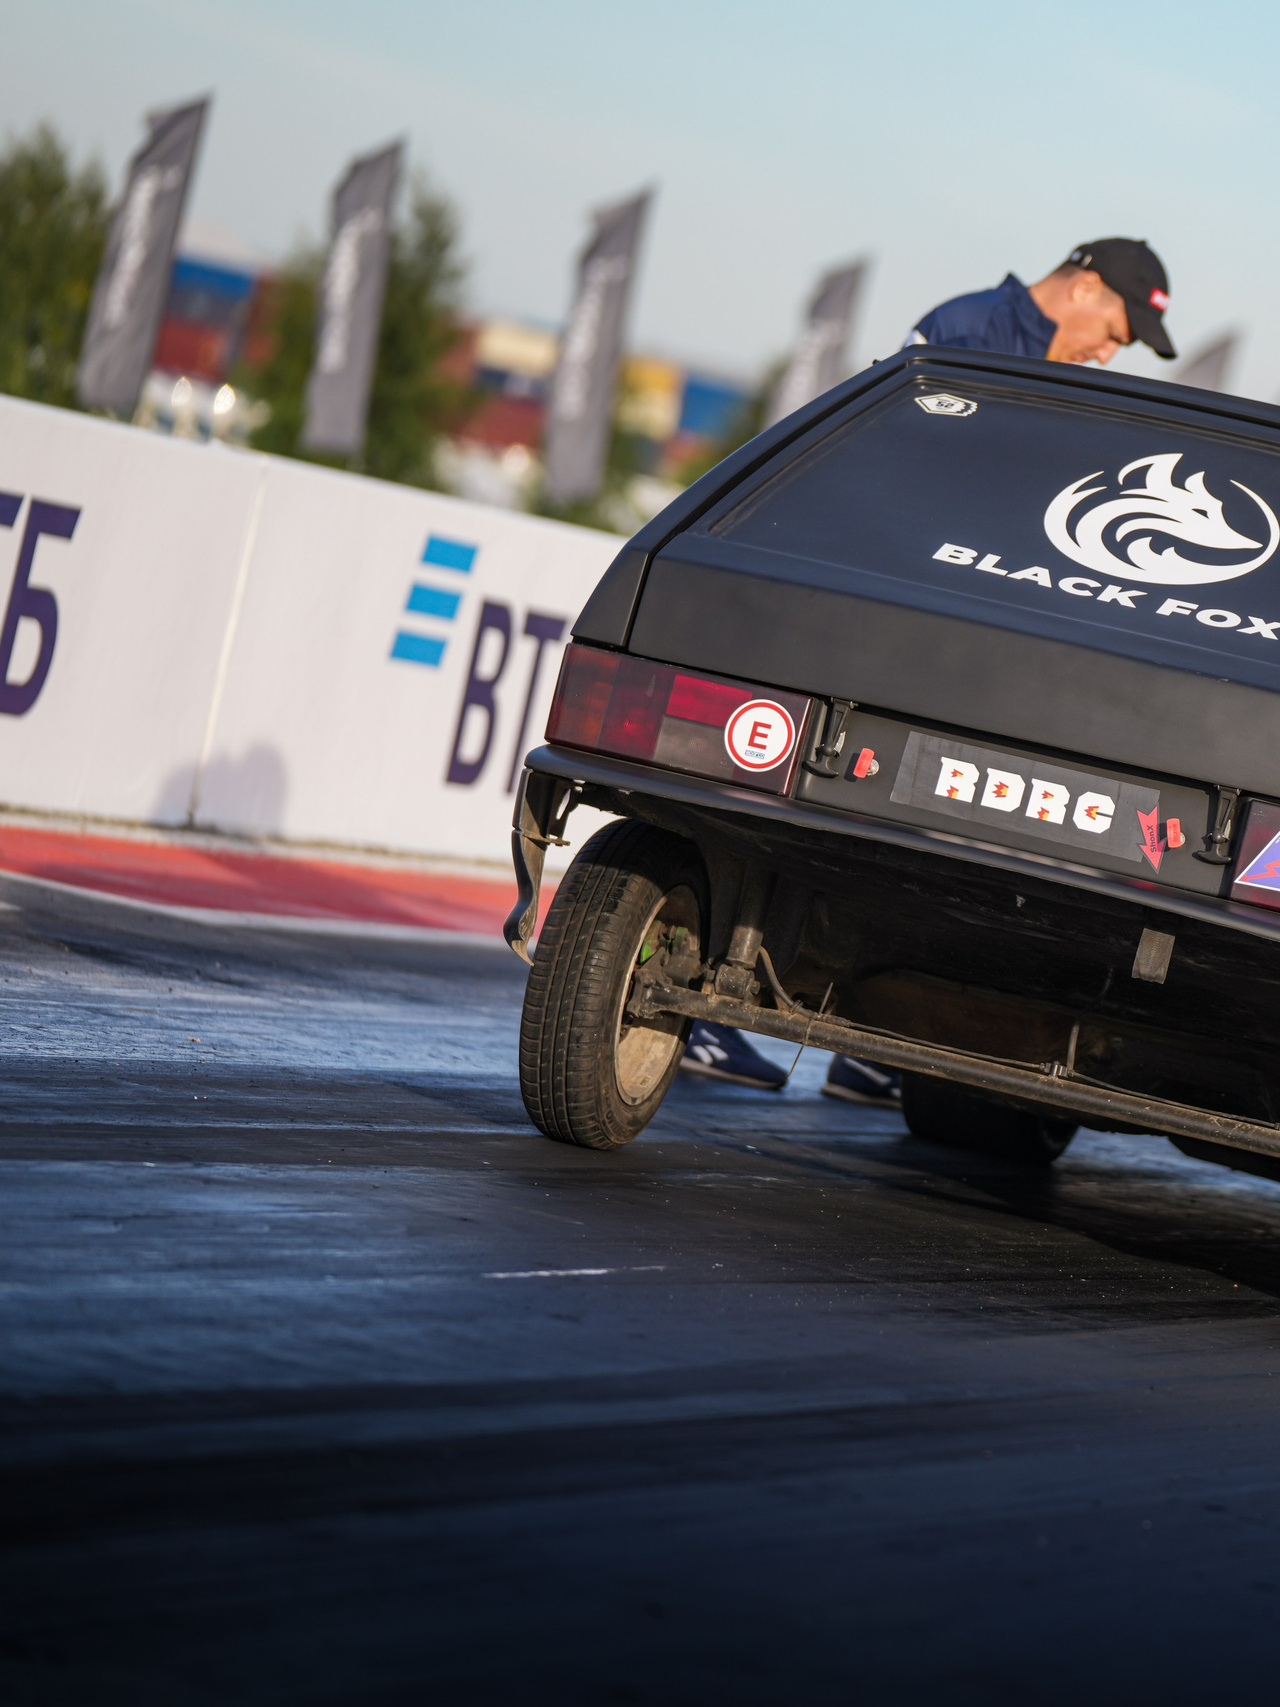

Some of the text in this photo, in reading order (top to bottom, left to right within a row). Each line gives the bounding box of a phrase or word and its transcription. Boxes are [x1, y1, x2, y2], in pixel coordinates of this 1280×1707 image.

[931, 543, 1147, 608] BLACK
[445, 600, 567, 794] ВТ
[748, 720, 772, 750] E
[935, 756, 1115, 834] RDRC
[1146, 824, 1157, 853] ShonX
